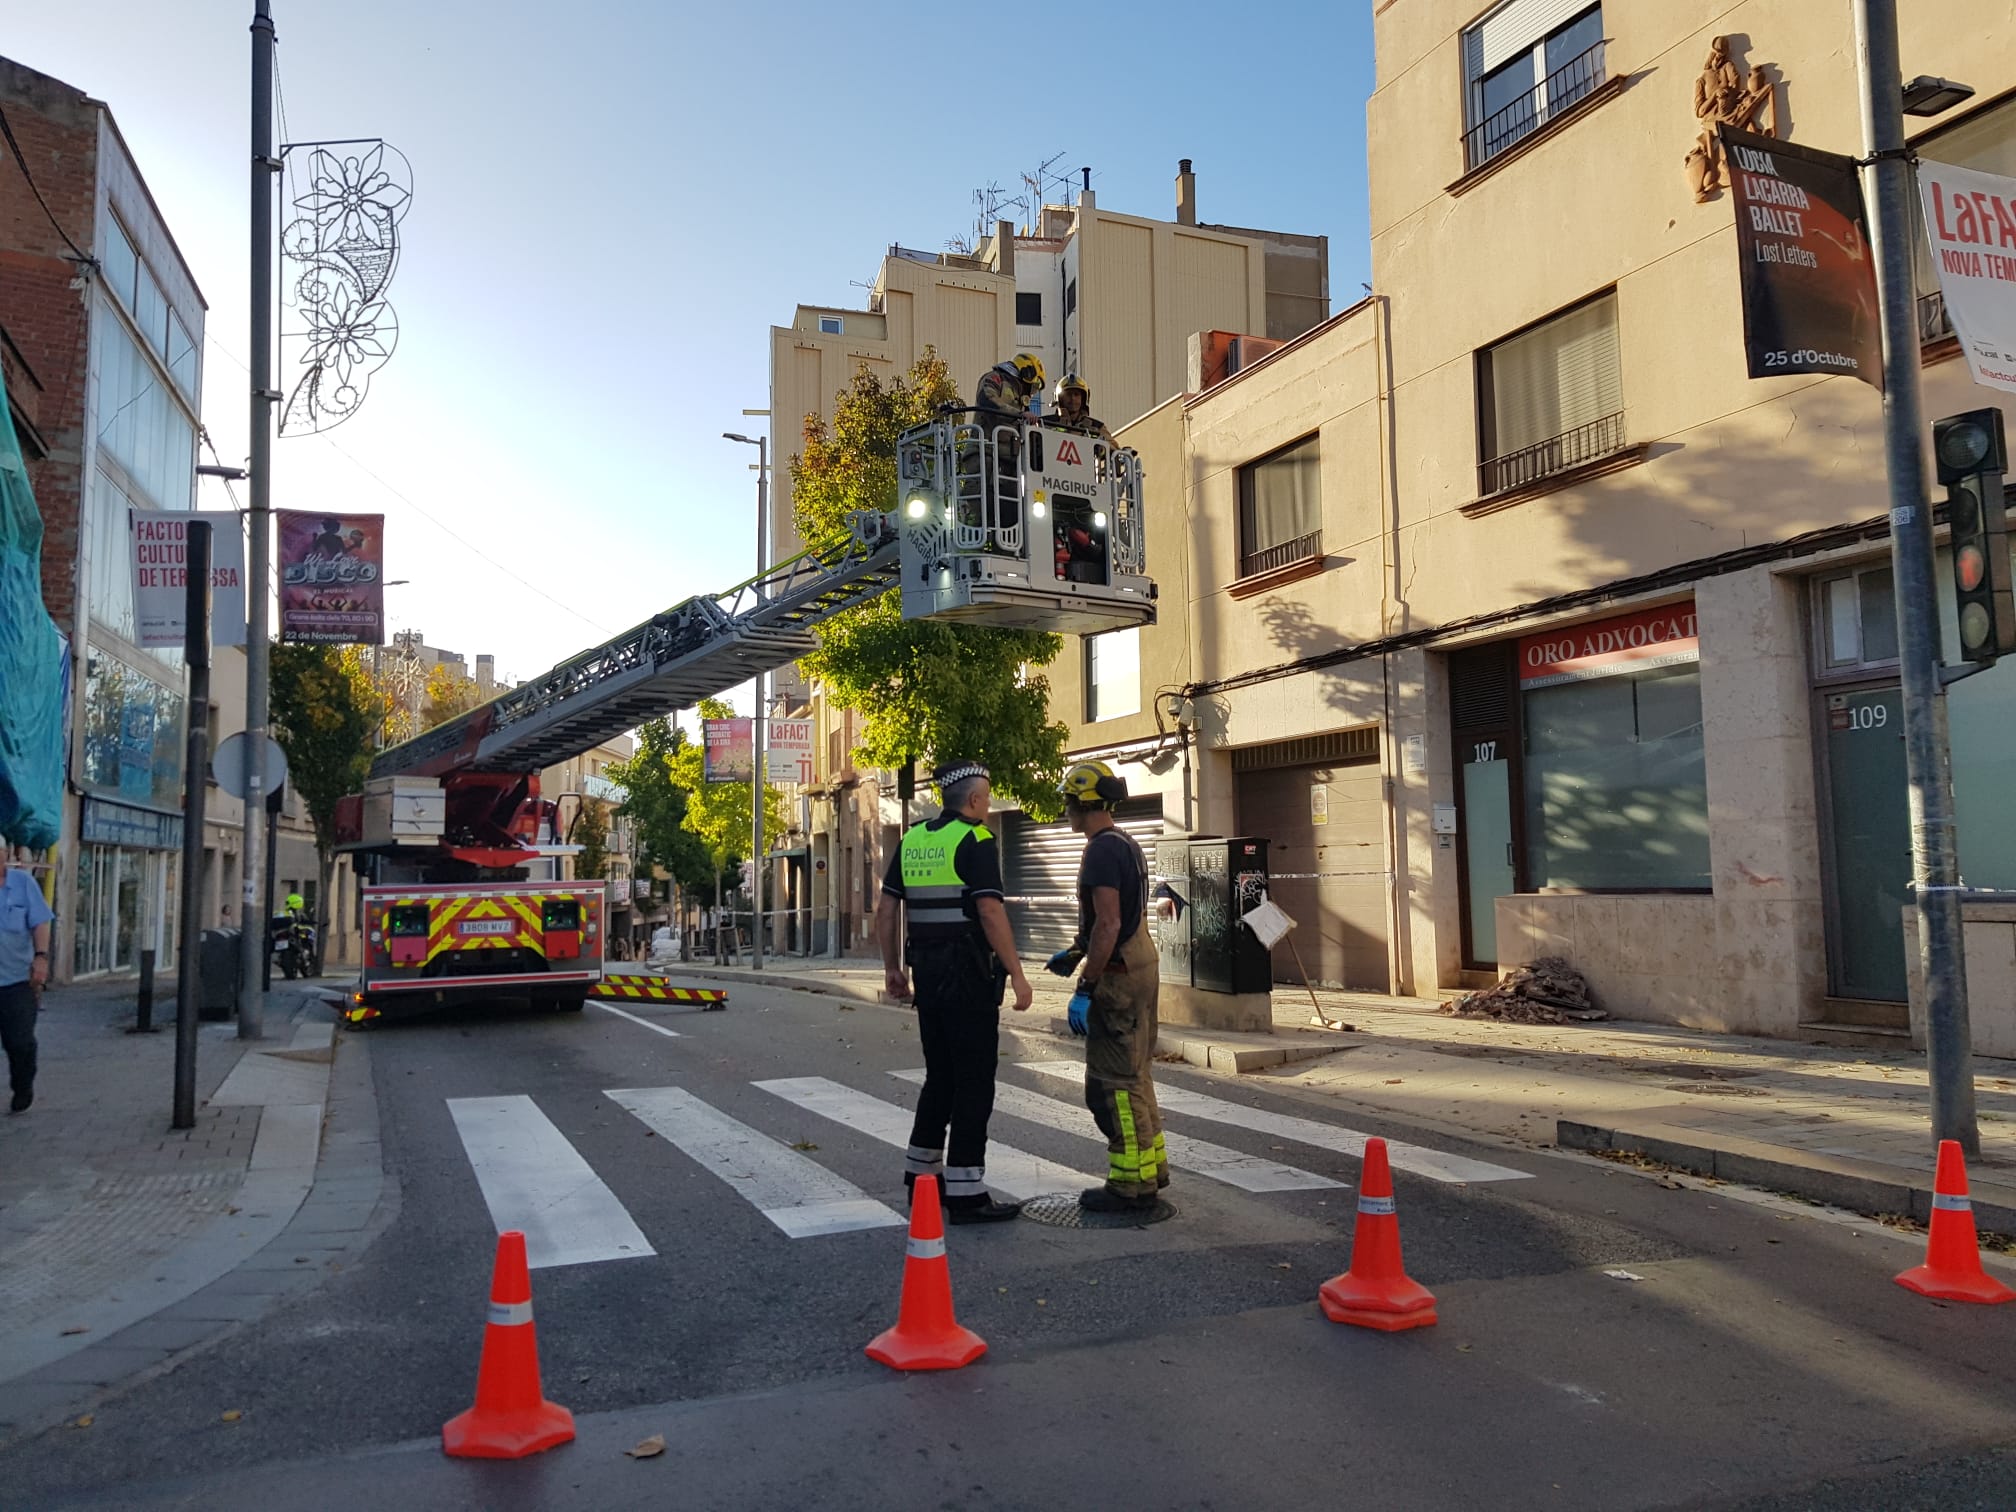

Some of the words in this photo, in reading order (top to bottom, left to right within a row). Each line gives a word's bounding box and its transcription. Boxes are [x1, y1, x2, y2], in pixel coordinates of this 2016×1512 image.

[1743, 174, 1811, 211] LACARRA
[1749, 205, 1804, 238] BALLET
[1755, 240, 1781, 263] Lost
[1781, 241, 1817, 269] Letters
[1941, 248, 1983, 278] NOVA
[1984, 253, 2016, 283] TEM
[1764, 351, 1788, 367] 25
[1791, 350, 1859, 369] d'Octubre
[1042, 475, 1097, 498] MAGIRUS
[137, 520, 189, 541] FACTO
[138, 544, 188, 564] CULTU
[906, 529, 940, 574] MAGIRUS
[140, 567, 158, 588] DE
[159, 567, 238, 588] TERSSA
[284, 562, 377, 584] DISCO
[285, 631, 297, 640] 22
[298, 631, 310, 640] de
[311, 631, 358, 641] Novembre
[1527, 639, 1575, 667] ORO
[1849, 704, 1887, 730] 109
[770, 723, 810, 741] LaFACT
[1474, 741, 1496, 763] 107
[904, 847, 945, 860] POLICIA
